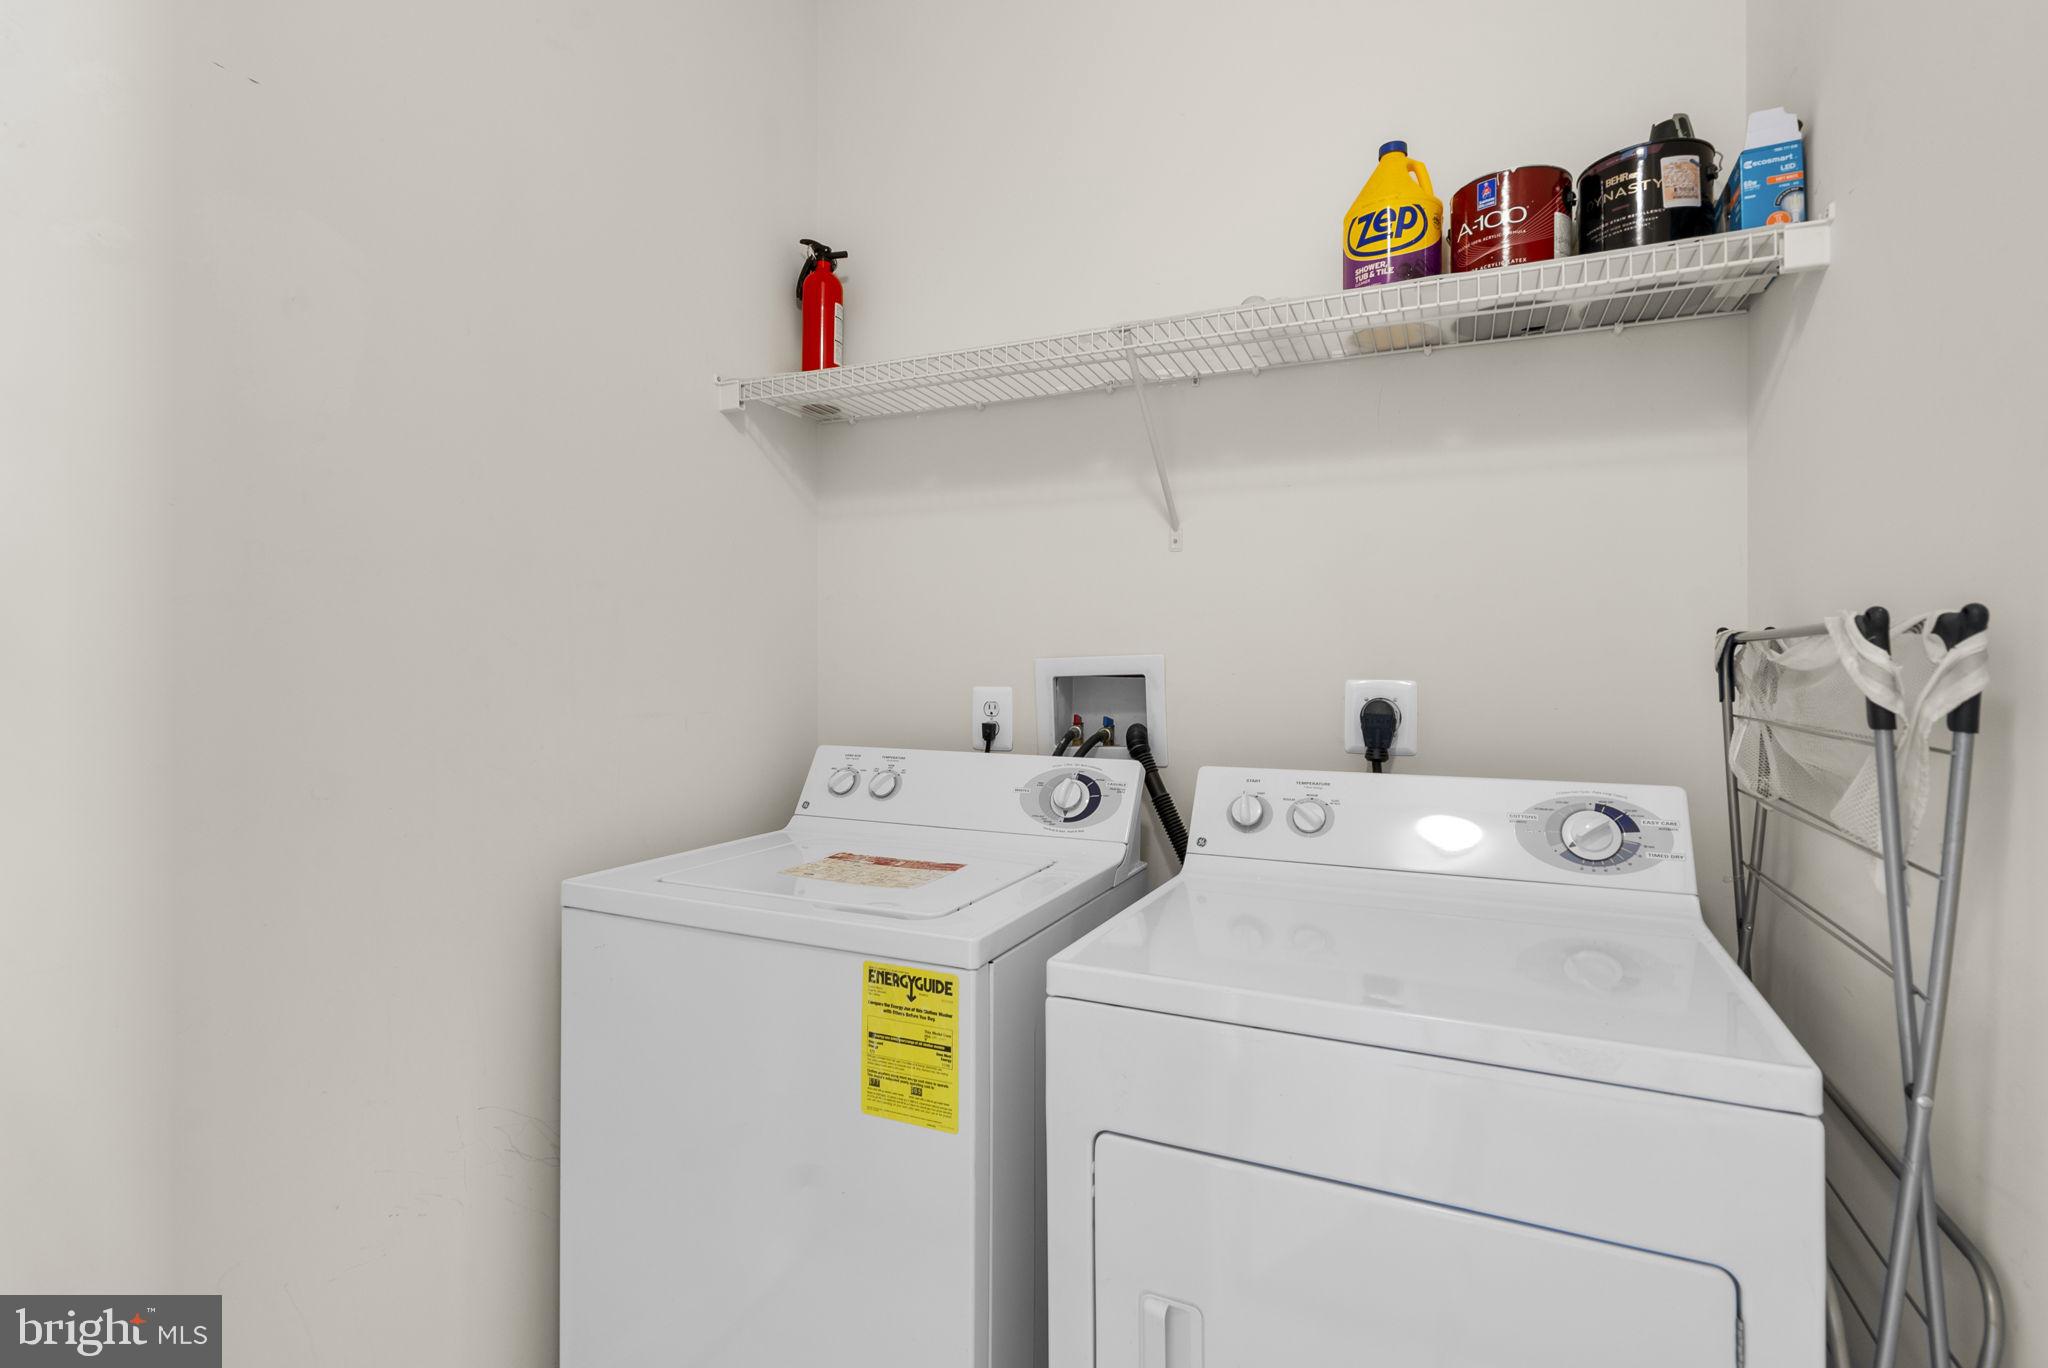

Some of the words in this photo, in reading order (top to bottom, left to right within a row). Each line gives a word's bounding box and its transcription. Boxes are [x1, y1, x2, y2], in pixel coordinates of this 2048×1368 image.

[1752, 154, 1793, 167] ecosmart
[1780, 163, 1796, 171] LED
[1605, 172, 1629, 188] BEHR
[1457, 206, 1527, 243] A-100
[1355, 272, 1369, 283] TUB
[1369, 270, 1375, 278] &
[1376, 266, 1394, 276] TILE
[869, 969, 953, 996] ENERGYGUIDE
